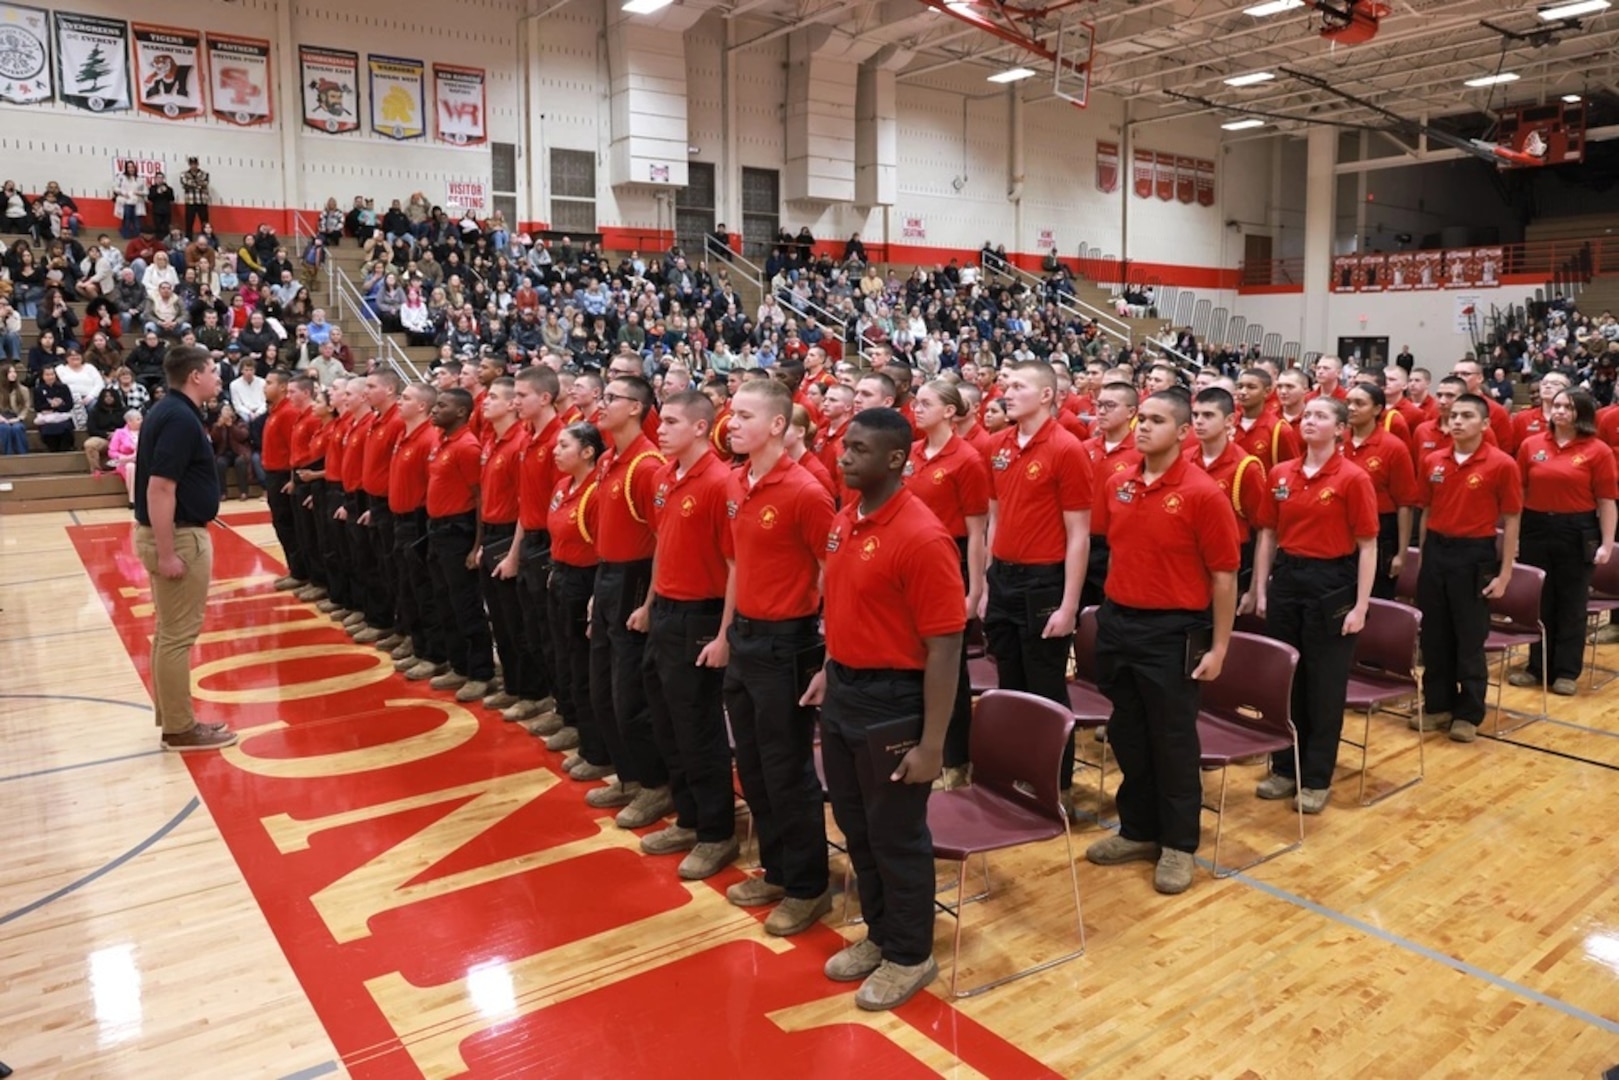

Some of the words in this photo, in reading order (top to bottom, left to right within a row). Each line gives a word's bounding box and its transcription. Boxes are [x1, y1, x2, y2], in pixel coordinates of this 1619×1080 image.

[62, 22, 120, 35] EVERGREENS
[81, 35, 117, 45] EVEREST
[150, 33, 184, 44] TIGERS
[142, 43, 193, 55] MARSHFIELD
[218, 43, 259, 53] PANTHERS
[303, 53, 355, 66] LUMBERJACKS
[306, 64, 333, 73] WAUSAU
[377, 64, 416, 74] WARRIORS
[374, 73, 400, 81] WAUSAU
[117, 158, 161, 174] VITOR
[449, 182, 482, 195] VISITOR
[907, 218, 922, 228] HOME
[903, 228, 925, 238] SEATING
[119, 573, 987, 1080] INCOLN
